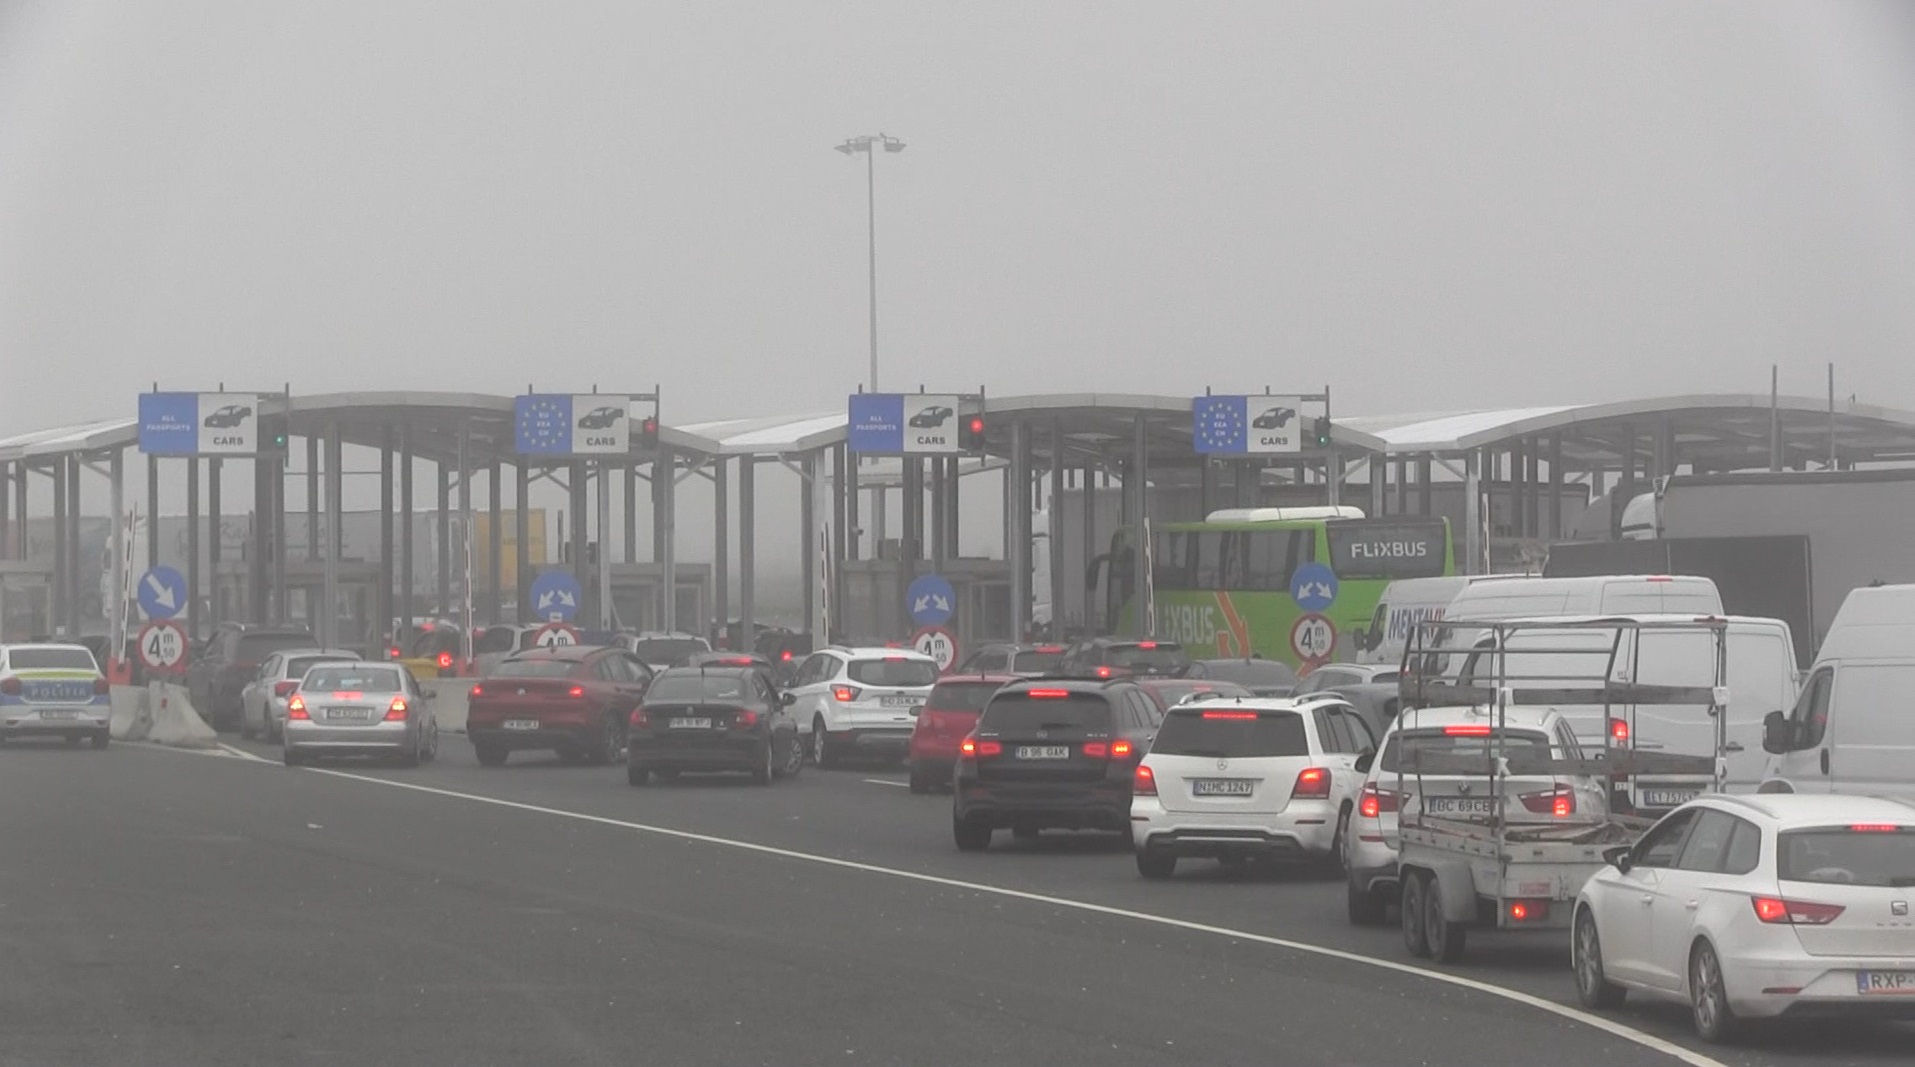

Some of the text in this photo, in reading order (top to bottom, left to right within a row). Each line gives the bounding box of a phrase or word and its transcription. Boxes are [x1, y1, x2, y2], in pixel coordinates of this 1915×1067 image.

[146, 424, 190, 432] PASSPORTS
[213, 437, 243, 446] CARS
[586, 437, 616, 446] CARS
[917, 436, 946, 445] CARS
[1260, 437, 1288, 446] CARS
[1301, 627, 1312, 650] 4
[149, 633, 160, 658] 4
[1871, 974, 1915, 989] RXP-
